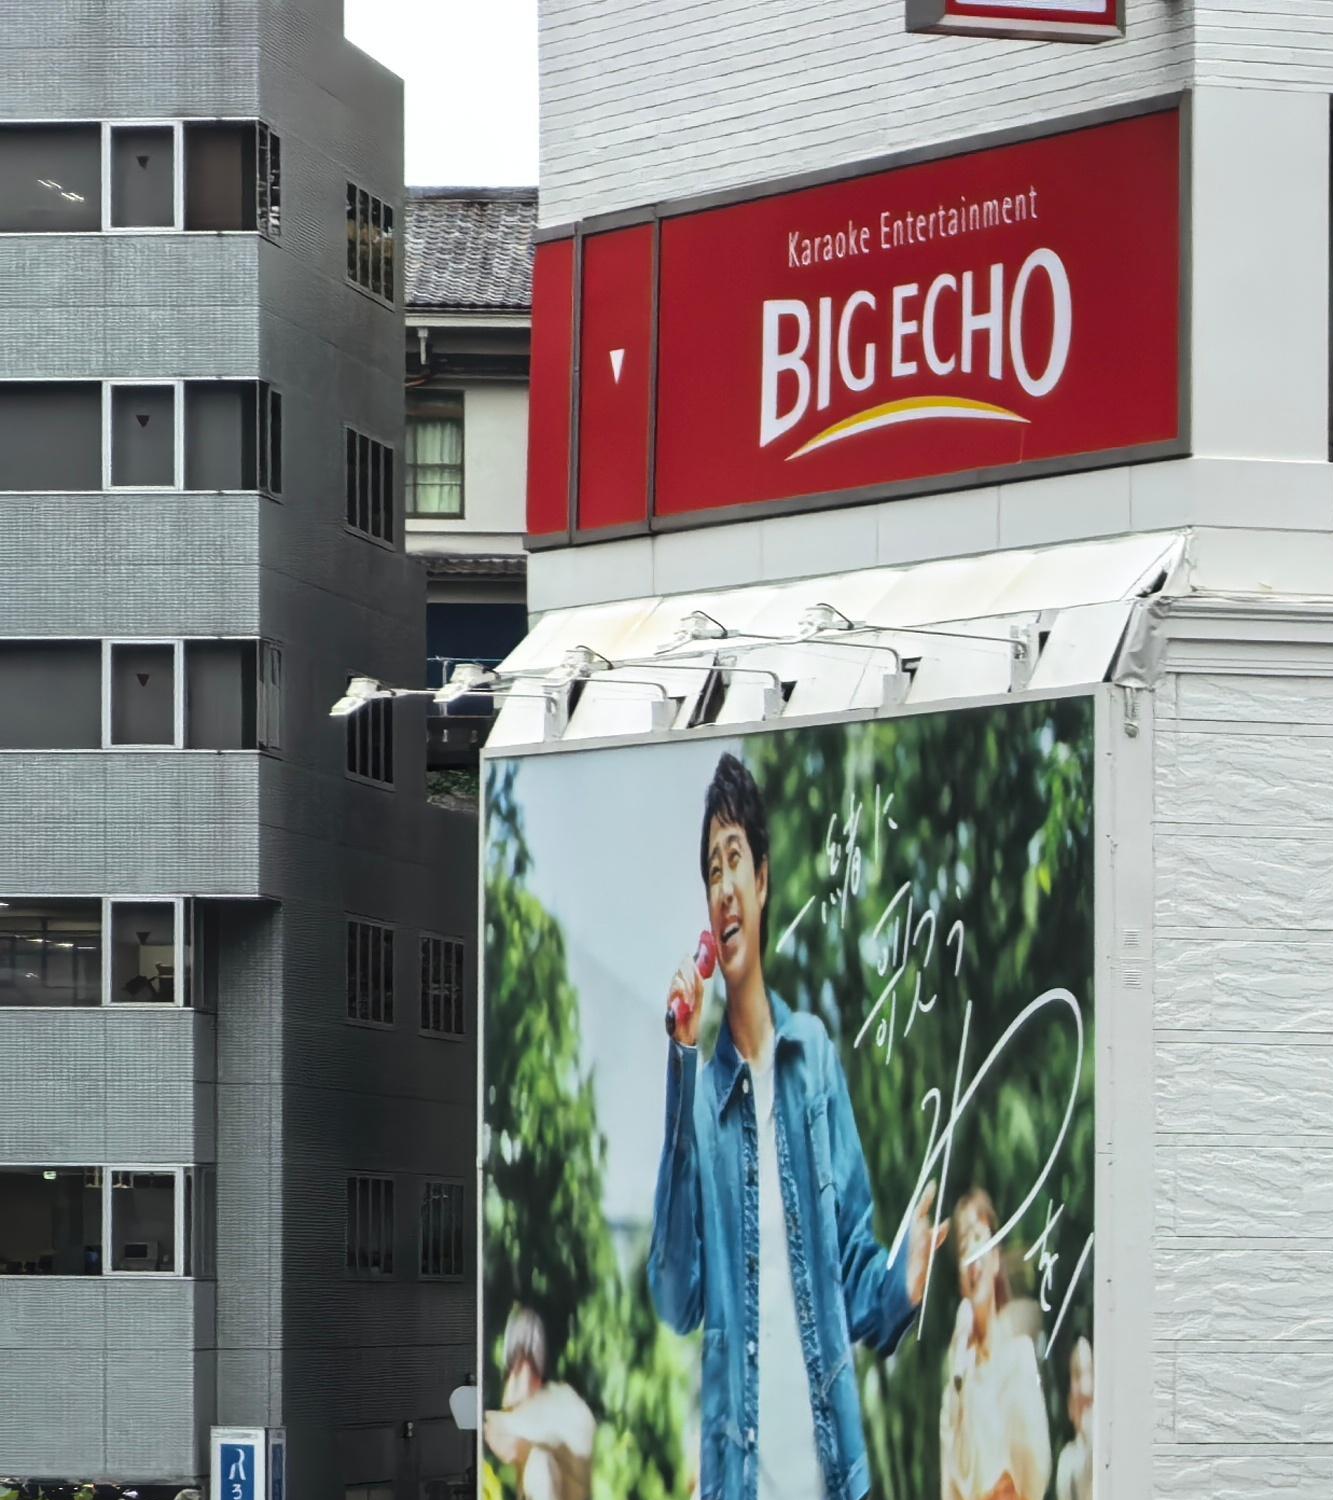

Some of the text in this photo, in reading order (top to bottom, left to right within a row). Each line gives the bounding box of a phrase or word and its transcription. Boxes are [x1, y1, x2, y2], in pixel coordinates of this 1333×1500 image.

[787, 184, 1038, 268] Karaoke Entertainment
[759, 247, 1073, 447] BIG ECHO
